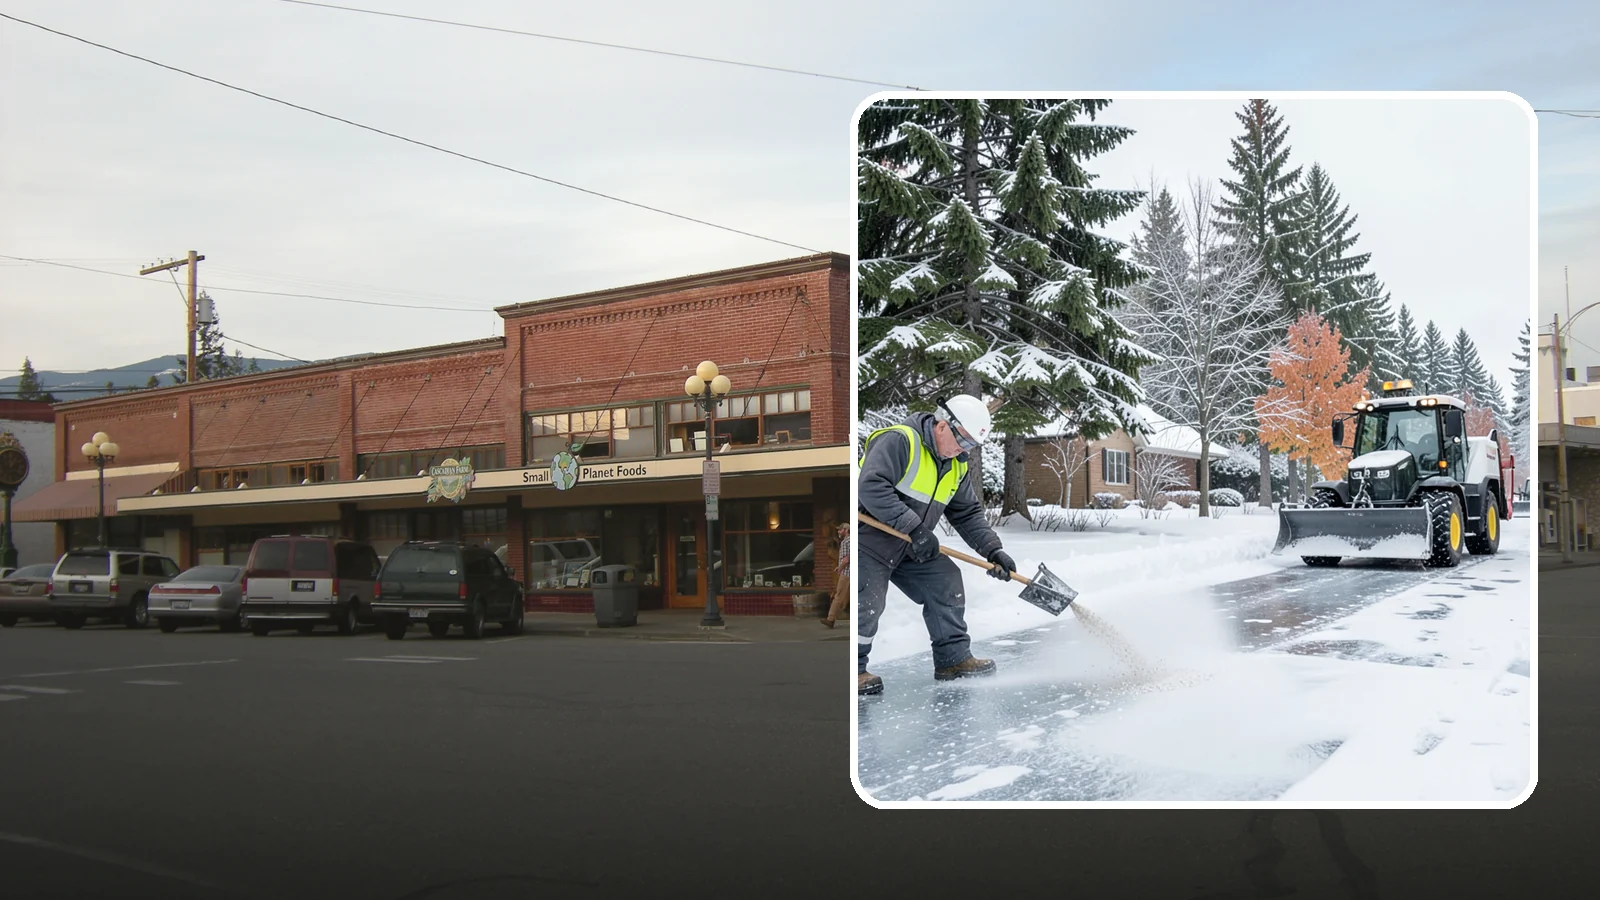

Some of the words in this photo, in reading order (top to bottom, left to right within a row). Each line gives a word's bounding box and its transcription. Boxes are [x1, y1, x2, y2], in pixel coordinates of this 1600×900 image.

[523, 471, 549, 483] Small
[582, 467, 614, 479] Planet
[616, 464, 647, 477] Foods
